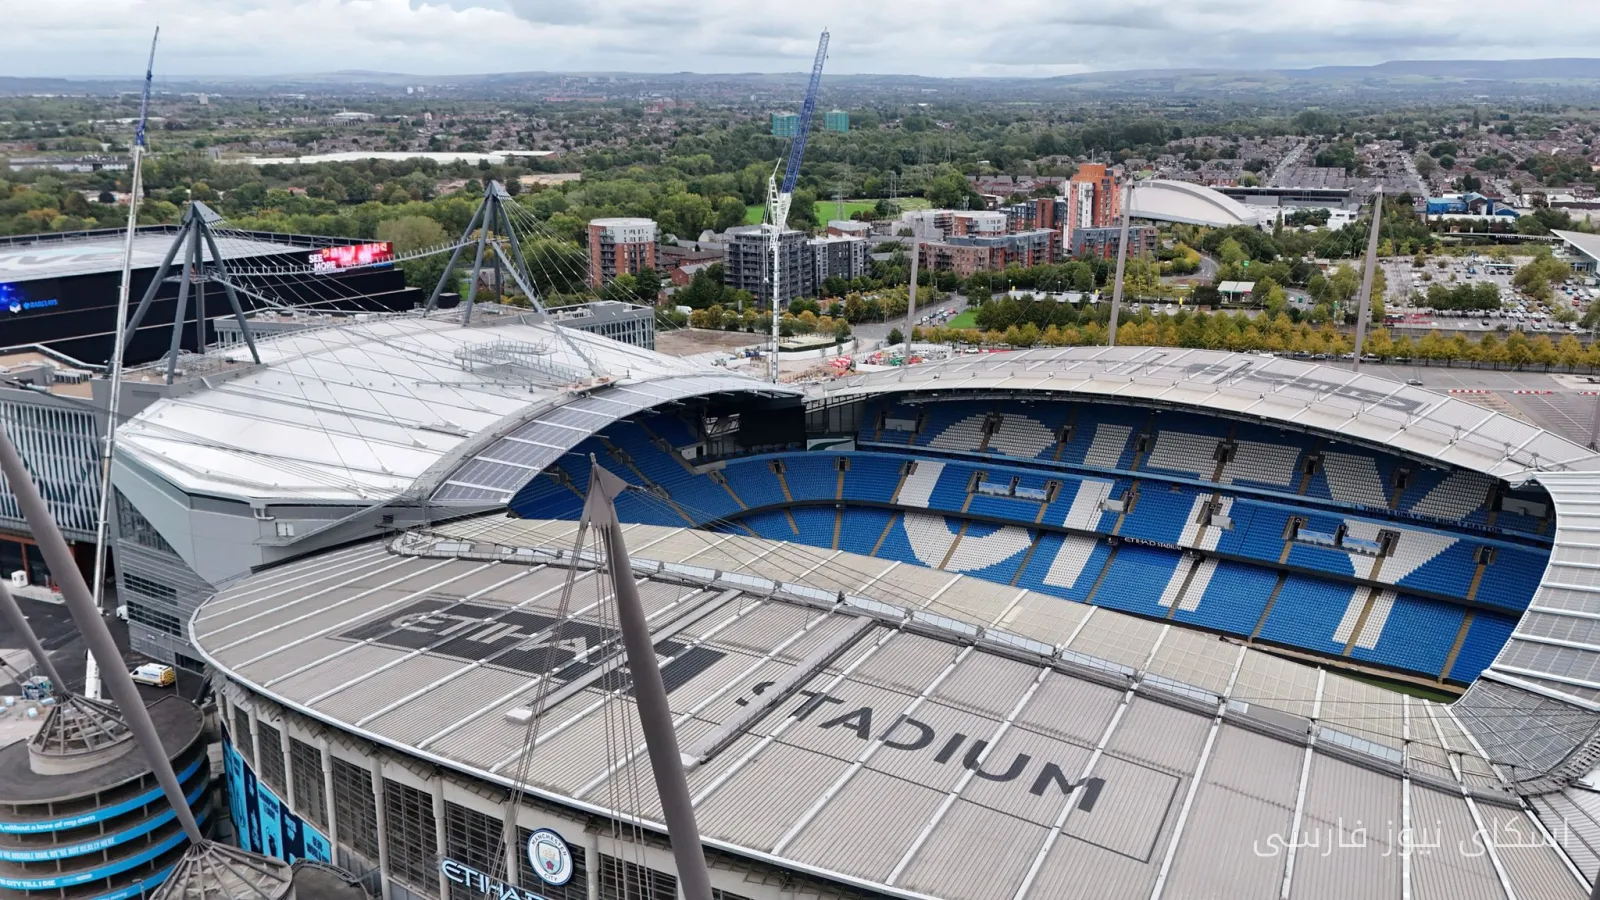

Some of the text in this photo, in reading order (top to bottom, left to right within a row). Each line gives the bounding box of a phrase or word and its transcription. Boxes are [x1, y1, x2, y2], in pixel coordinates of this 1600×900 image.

[308, 254, 323, 263] SEE
[313, 261, 336, 271] MORE
[1395, 510, 1418, 519] ONLY
[1467, 521, 1502, 533] HATTON
[1124, 536, 1182, 551] ETIHAD STADIUM
[5, 823, 30, 831] without
[64, 819, 77, 827] my
[68, 845, 80, 855] NOT
[80, 841, 100, 852] REALLY
[101, 837, 116, 848] HERE
[531, 832, 568, 858] MANCHESTER
[6, 879, 23, 888] CITY
[23, 880, 38, 888] TILL
[42, 879, 56, 887] DIE
[544, 873, 558, 882] CITY
